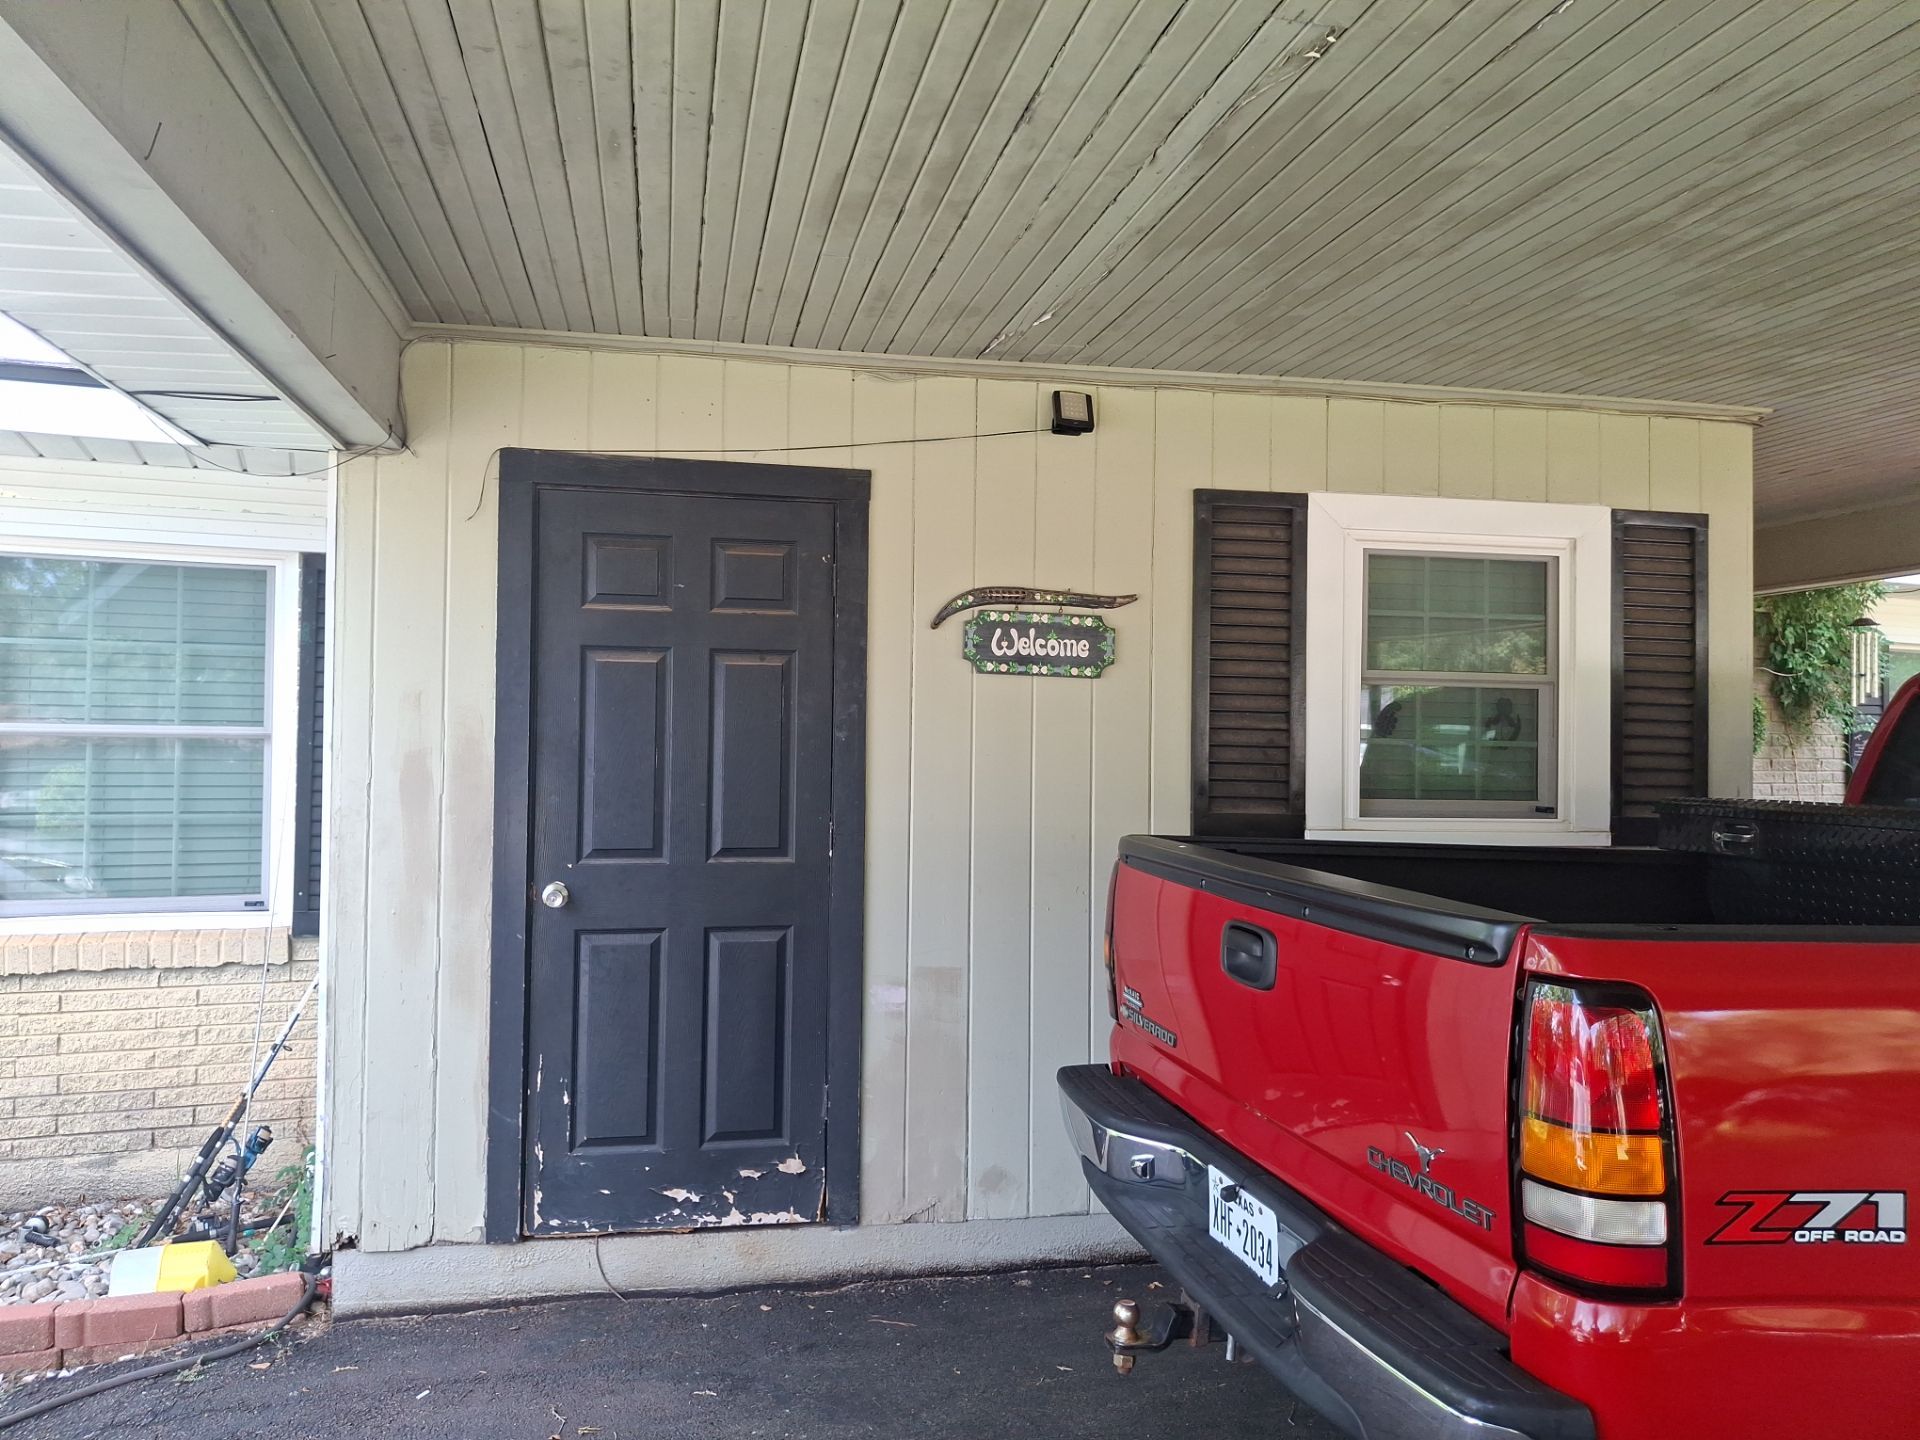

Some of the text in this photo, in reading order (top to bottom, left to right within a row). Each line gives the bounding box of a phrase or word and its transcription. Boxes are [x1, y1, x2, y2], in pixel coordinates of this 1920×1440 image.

[991, 627, 1090, 658] Welcome
[1127, 1008, 1177, 1048] SILVERADO
[1367, 1146, 1496, 1232] CHEVROLET
[1212, 1194, 1273, 1276] XHF 2034
[1704, 1190, 1907, 1245] Z71
[1794, 1230, 1906, 1243] OFF ROAD
